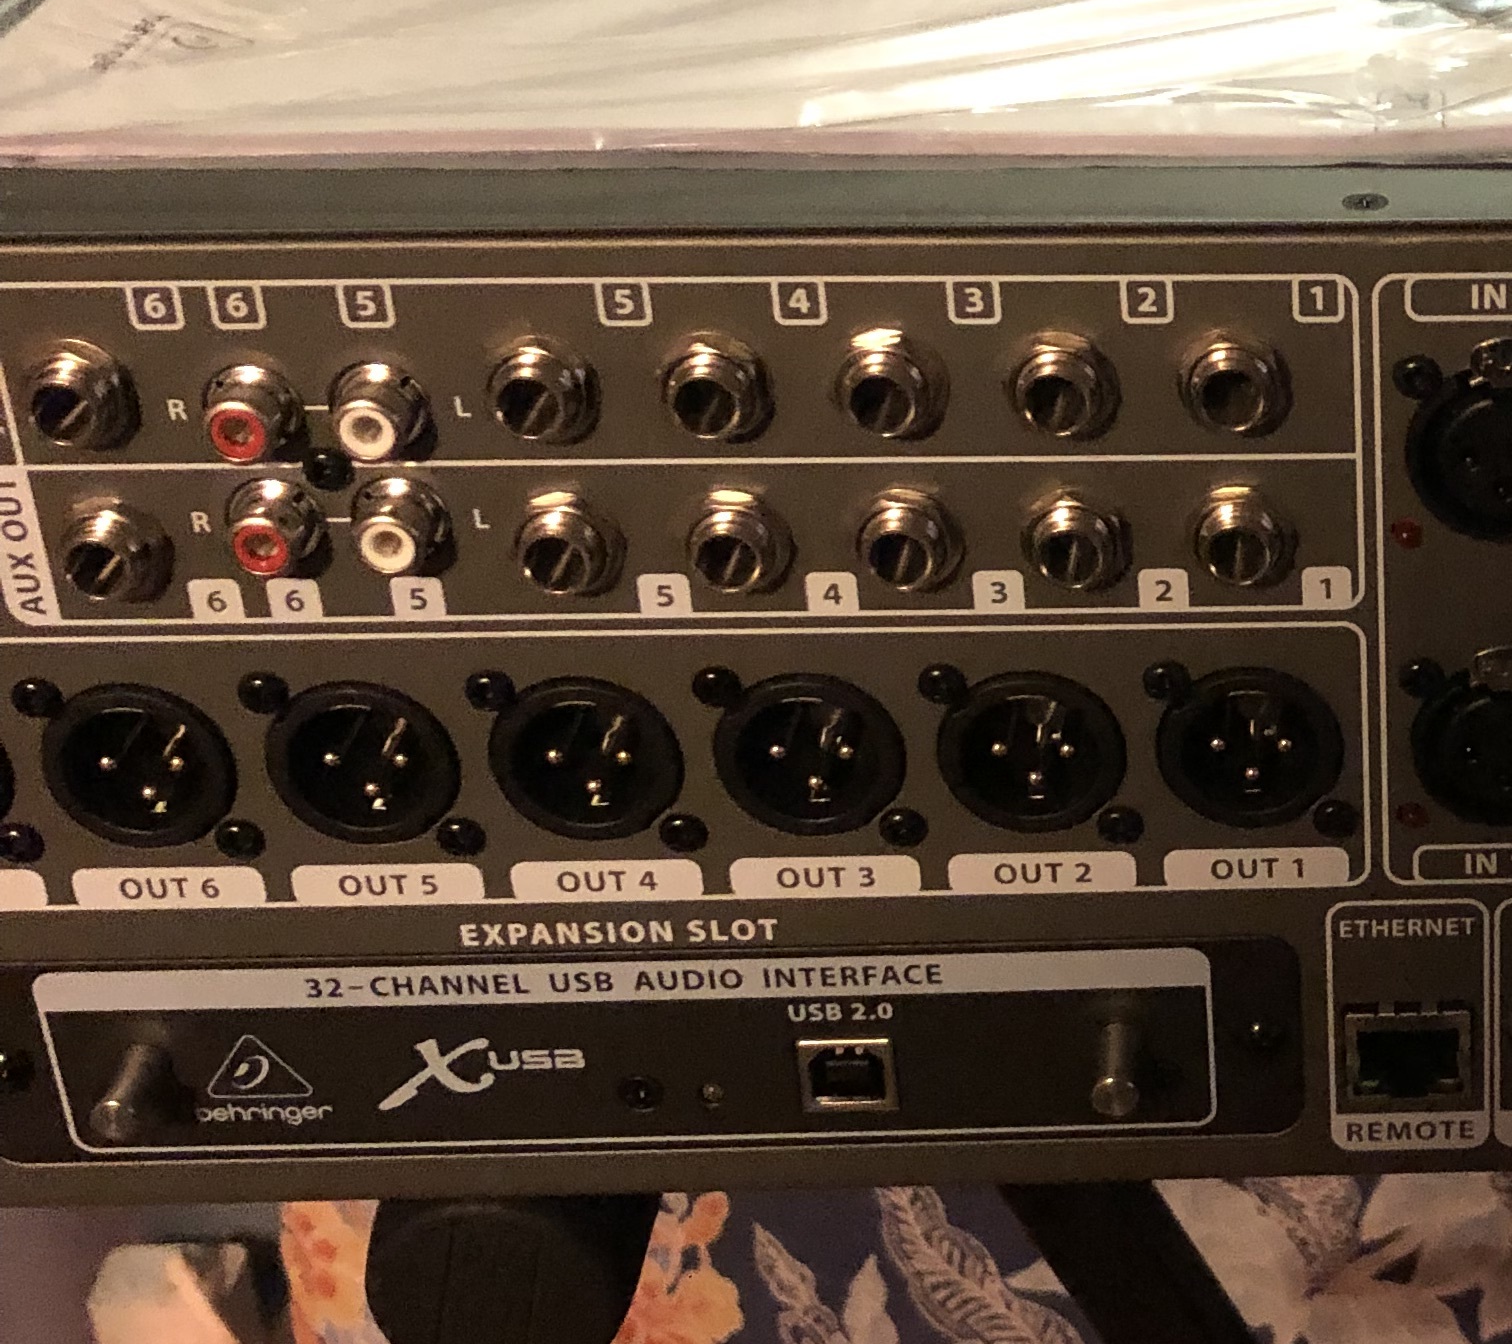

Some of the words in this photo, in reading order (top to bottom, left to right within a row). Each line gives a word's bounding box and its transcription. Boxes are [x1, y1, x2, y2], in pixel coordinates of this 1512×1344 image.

[143, 292, 166, 319] 6
[225, 292, 249, 318] 6
[356, 290, 376, 317] 5
[614, 288, 634, 315] 5
[788, 288, 811, 314] 4
[964, 287, 984, 313] 3
[1137, 286, 1157, 312] 2
[1310, 285, 1324, 311] 1
[1471, 283, 1508, 310] IN
[167, 398, 188, 421] R
[454, 396, 472, 418] L
[190, 511, 211, 533] R
[472, 508, 490, 530] L
[11, 552, 47, 615] AUX
[823, 583, 842, 605] 4
[990, 581, 1008, 604] 3
[1155, 579, 1173, 602] 2
[1320, 577, 1332, 600] 1
[206, 590, 227, 613] 6
[285, 589, 305, 612] 6
[410, 587, 428, 611] 5
[657, 584, 675, 608] 5
[994, 862, 1063, 885] OUT
[1075, 862, 1092, 883] 2
[1210, 857, 1279, 880] OUT
[1292, 858, 1304, 878] 1
[1464, 852, 1498, 876] IN
[119, 877, 188, 900] OUT
[200, 877, 220, 899] 6
[338, 874, 407, 897] OUT
[421, 874, 439, 896] 5
[556, 870, 626, 893] OUT
[639, 870, 658, 891] 4
[776, 866, 846, 889] OUT
[858, 866, 876, 888] 3
[459, 920, 673, 947] EXPANSION
[687, 918, 778, 943] SLOT
[1339, 917, 1474, 939] ETHERNET
[305, 973, 530, 999] 32-CHANNEL
[548, 971, 614, 993] USB
[634, 968, 743, 991] AUDIO
[763, 963, 943, 988] INTERFACE
[787, 1003, 842, 1022] USB
[851, 1002, 893, 1021] 2.0
[1346, 1119, 1475, 1142] REMOTE
